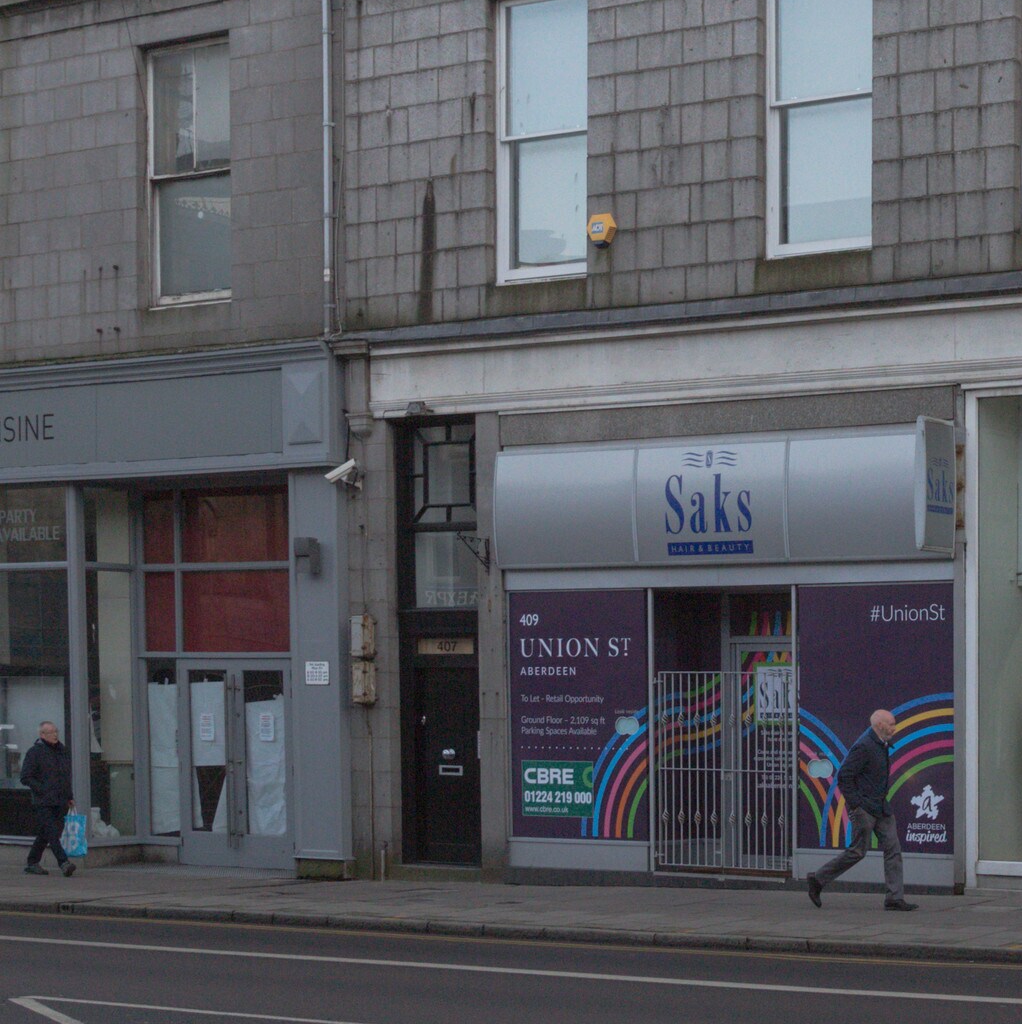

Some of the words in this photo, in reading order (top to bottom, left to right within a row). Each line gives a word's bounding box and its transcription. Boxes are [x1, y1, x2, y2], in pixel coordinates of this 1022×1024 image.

[0, 414, 54, 442] SINE
[665, 473, 752, 535] Saks
[0, 509, 37, 523] PARTY
[671, 544, 695, 553] HAIR
[707, 542, 750, 552] BEAUTY
[870, 603, 946, 622] #UnionSt
[519, 614, 539, 626] 409
[437, 641, 457, 652] 407
[520, 637, 599, 657] UNION
[520, 666, 576, 676] ABERDEEN
[545, 694, 563, 702] Retail
[564, 695, 604, 704] Opportunity
[521, 716, 545, 724] Ground
[546, 716, 562, 724] Floor
[590, 718, 599, 726] sq
[521, 726, 544, 736] Parking
[545, 726, 568, 736] Spaces
[569, 726, 597, 735] Available
[524, 767, 574, 784] CBRE
[524, 790, 553, 803] 01224
[555, 791, 573, 803] 219
[574, 792, 592, 804] 000
[525, 805, 568, 813] www.cbre.co.uk
[907, 823, 946, 831] ABERDEEN
[906, 830, 947, 844] inspired
